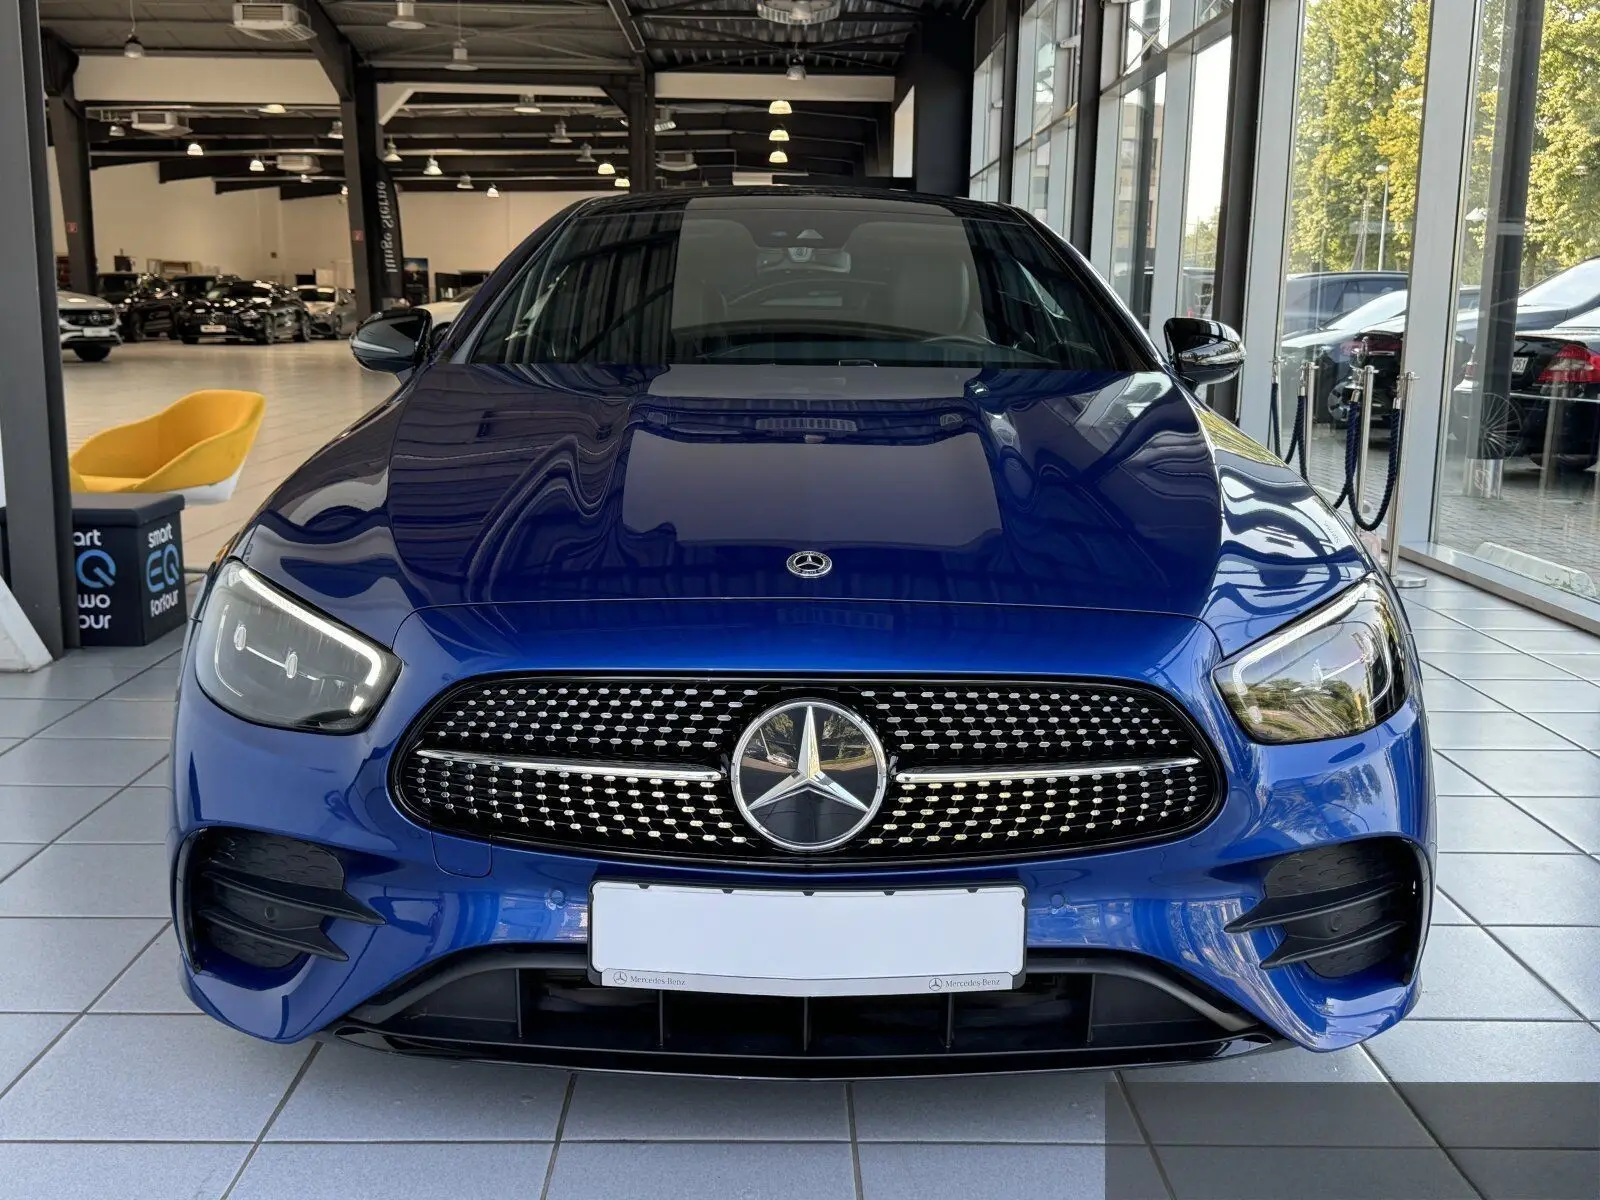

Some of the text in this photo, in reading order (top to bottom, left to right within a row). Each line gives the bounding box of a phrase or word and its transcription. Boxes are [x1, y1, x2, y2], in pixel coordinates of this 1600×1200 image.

[73, 529, 102, 546] art
[148, 522, 173, 548] smart
[76, 549, 116, 589] Q
[146, 544, 179, 593] EQ
[78, 593, 111, 609] wo
[79, 614, 112, 629] our
[630, 975, 686, 986] Mercedes-Benz
[945, 979, 1001, 988] Mercedes-Benz
